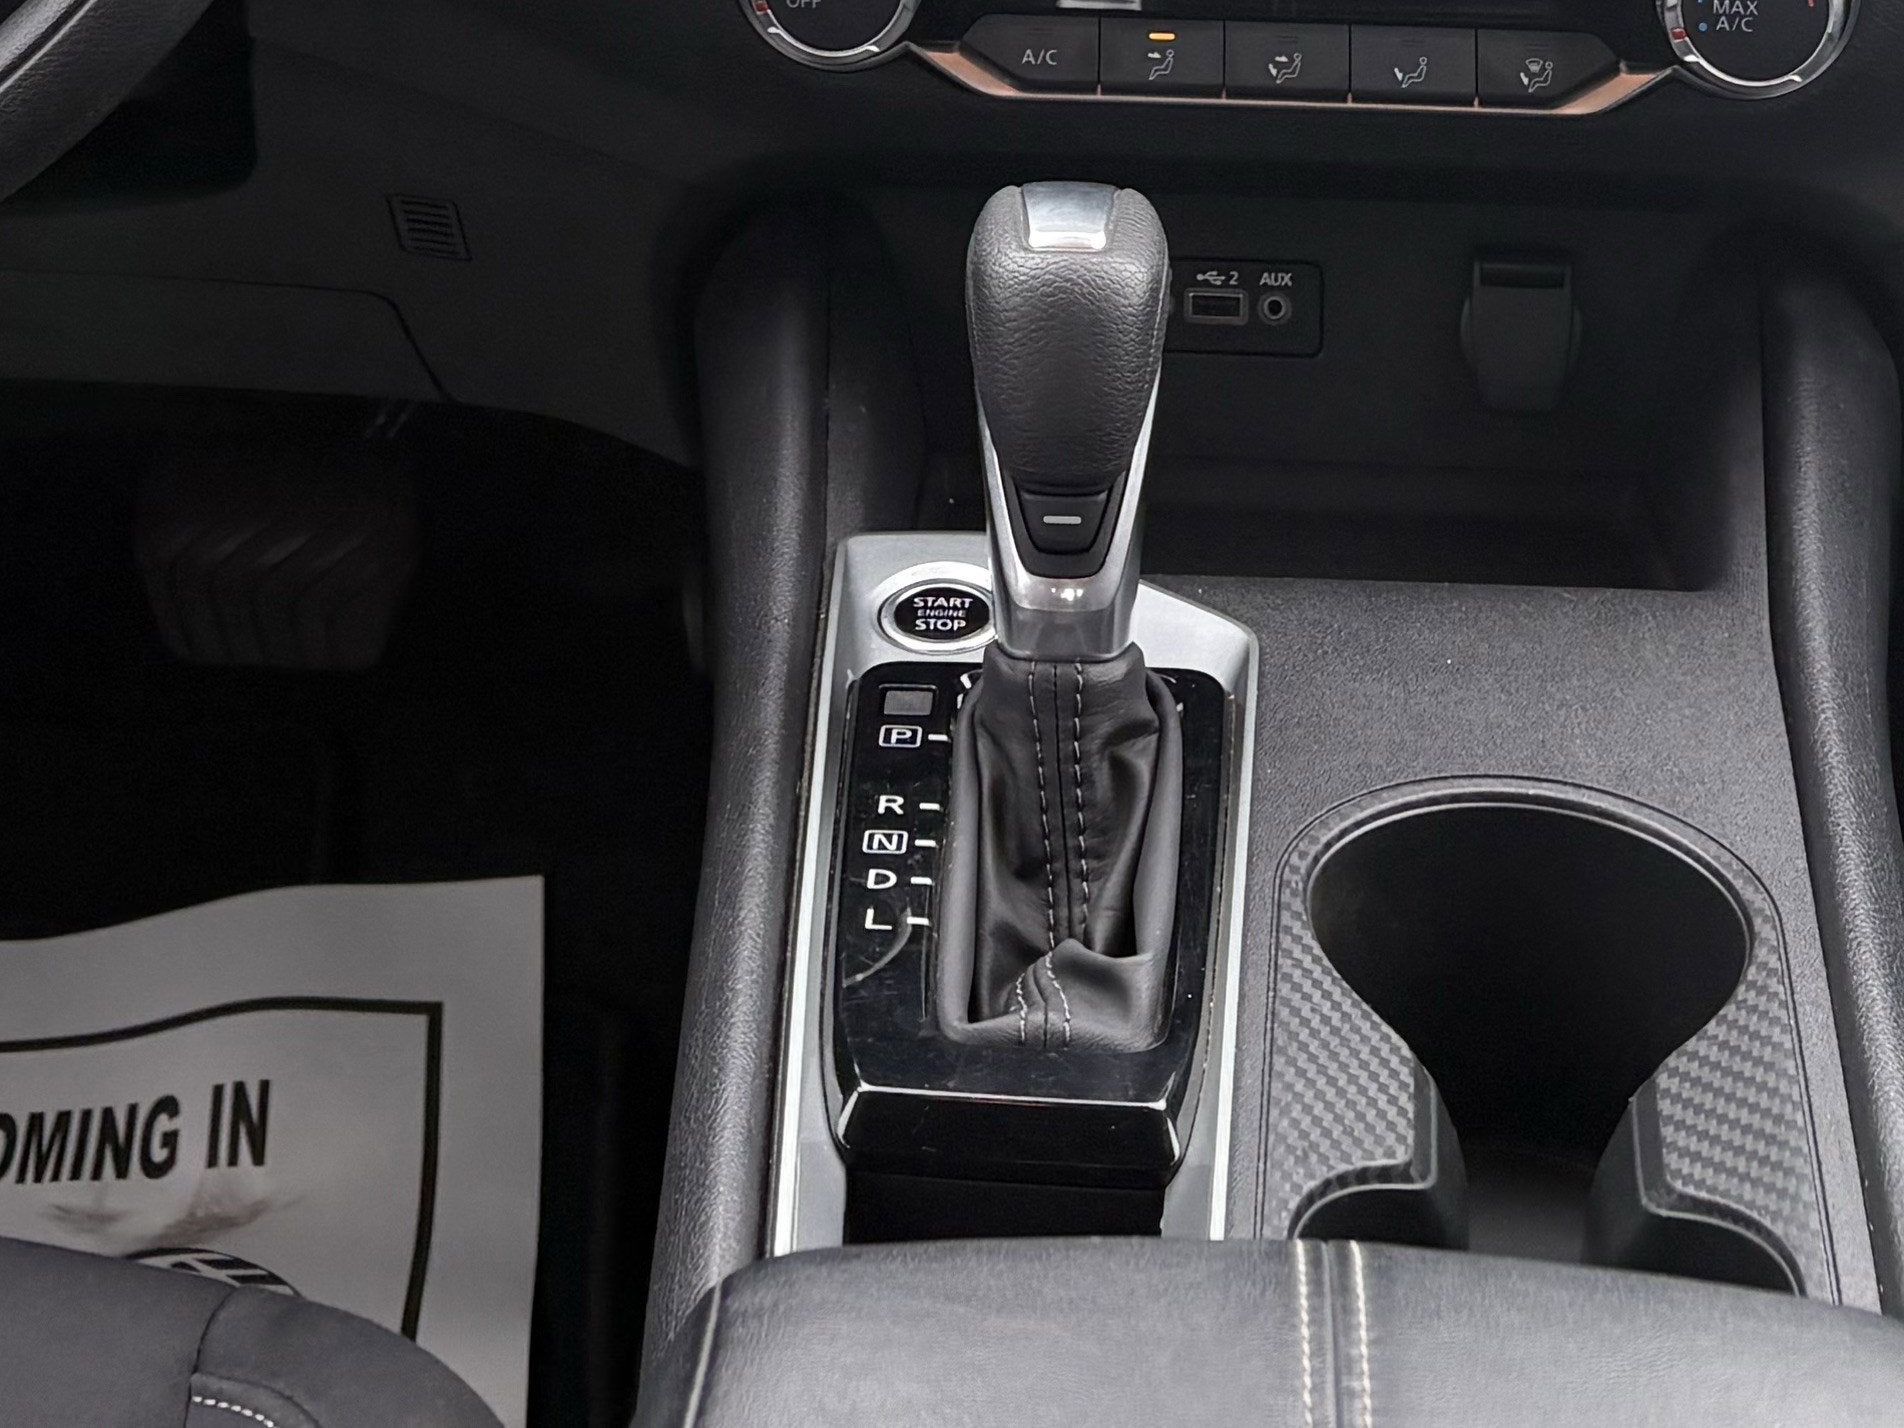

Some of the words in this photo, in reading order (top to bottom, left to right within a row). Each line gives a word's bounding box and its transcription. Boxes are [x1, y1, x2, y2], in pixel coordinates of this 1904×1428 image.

[1712, 0, 1759, 16] MAX
[1716, 17, 1754, 33] A/C
[1021, 49, 1058, 67] A/C
[1229, 271, 1240, 286] 2
[1259, 272, 1293, 287] AUX
[913, 597, 973, 609] START
[917, 609, 966, 617] ENGINE
[915, 618, 967, 631] STOP
[889, 730, 913, 743] P
[877, 796, 905, 815] R
[872, 834, 898, 850] N
[866, 870, 898, 890] D
[864, 908, 893, 931] L
[205, 1078, 271, 1170] IN
